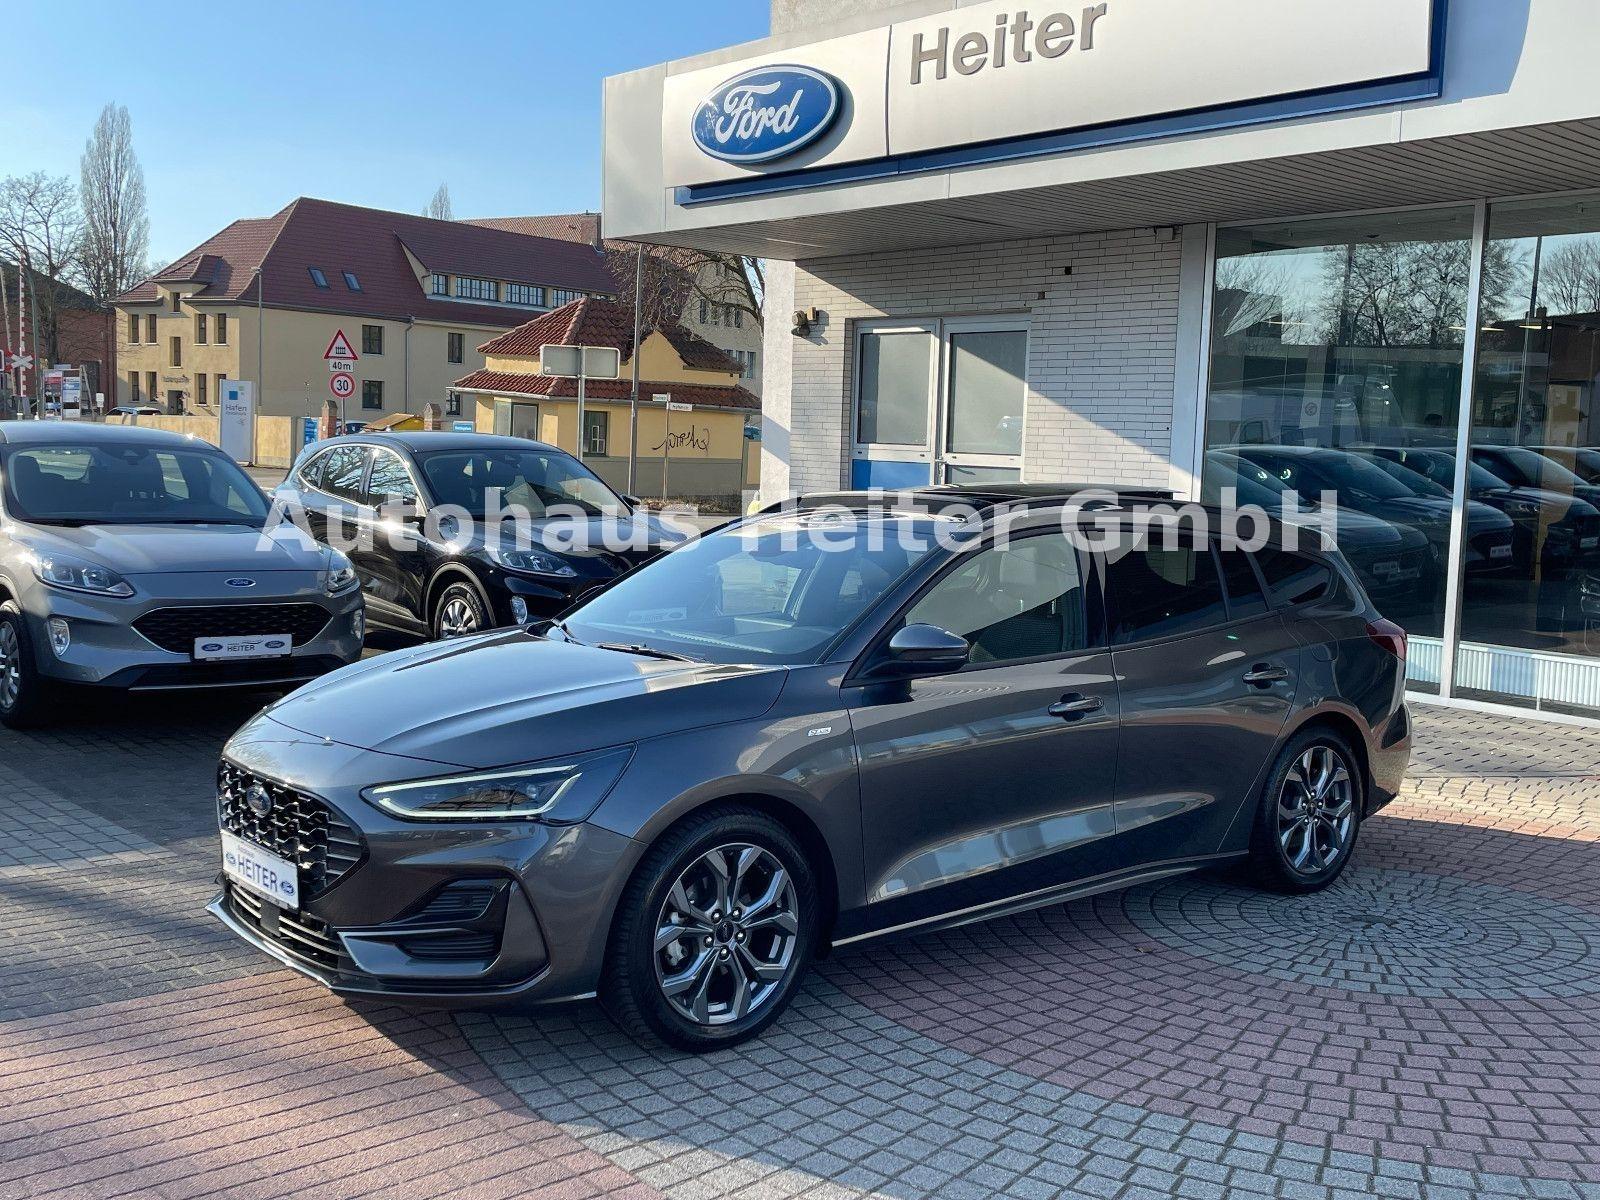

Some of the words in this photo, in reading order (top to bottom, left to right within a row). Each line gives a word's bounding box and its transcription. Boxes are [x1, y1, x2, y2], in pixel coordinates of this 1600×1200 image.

[910, 3, 1107, 85] Heiter
[716, 80, 802, 144] Ford
[336, 379, 349, 391] 30
[225, 403, 247, 411] Hafen
[227, 644, 255, 652] HEITER
[238, 853, 278, 892] HEITER
